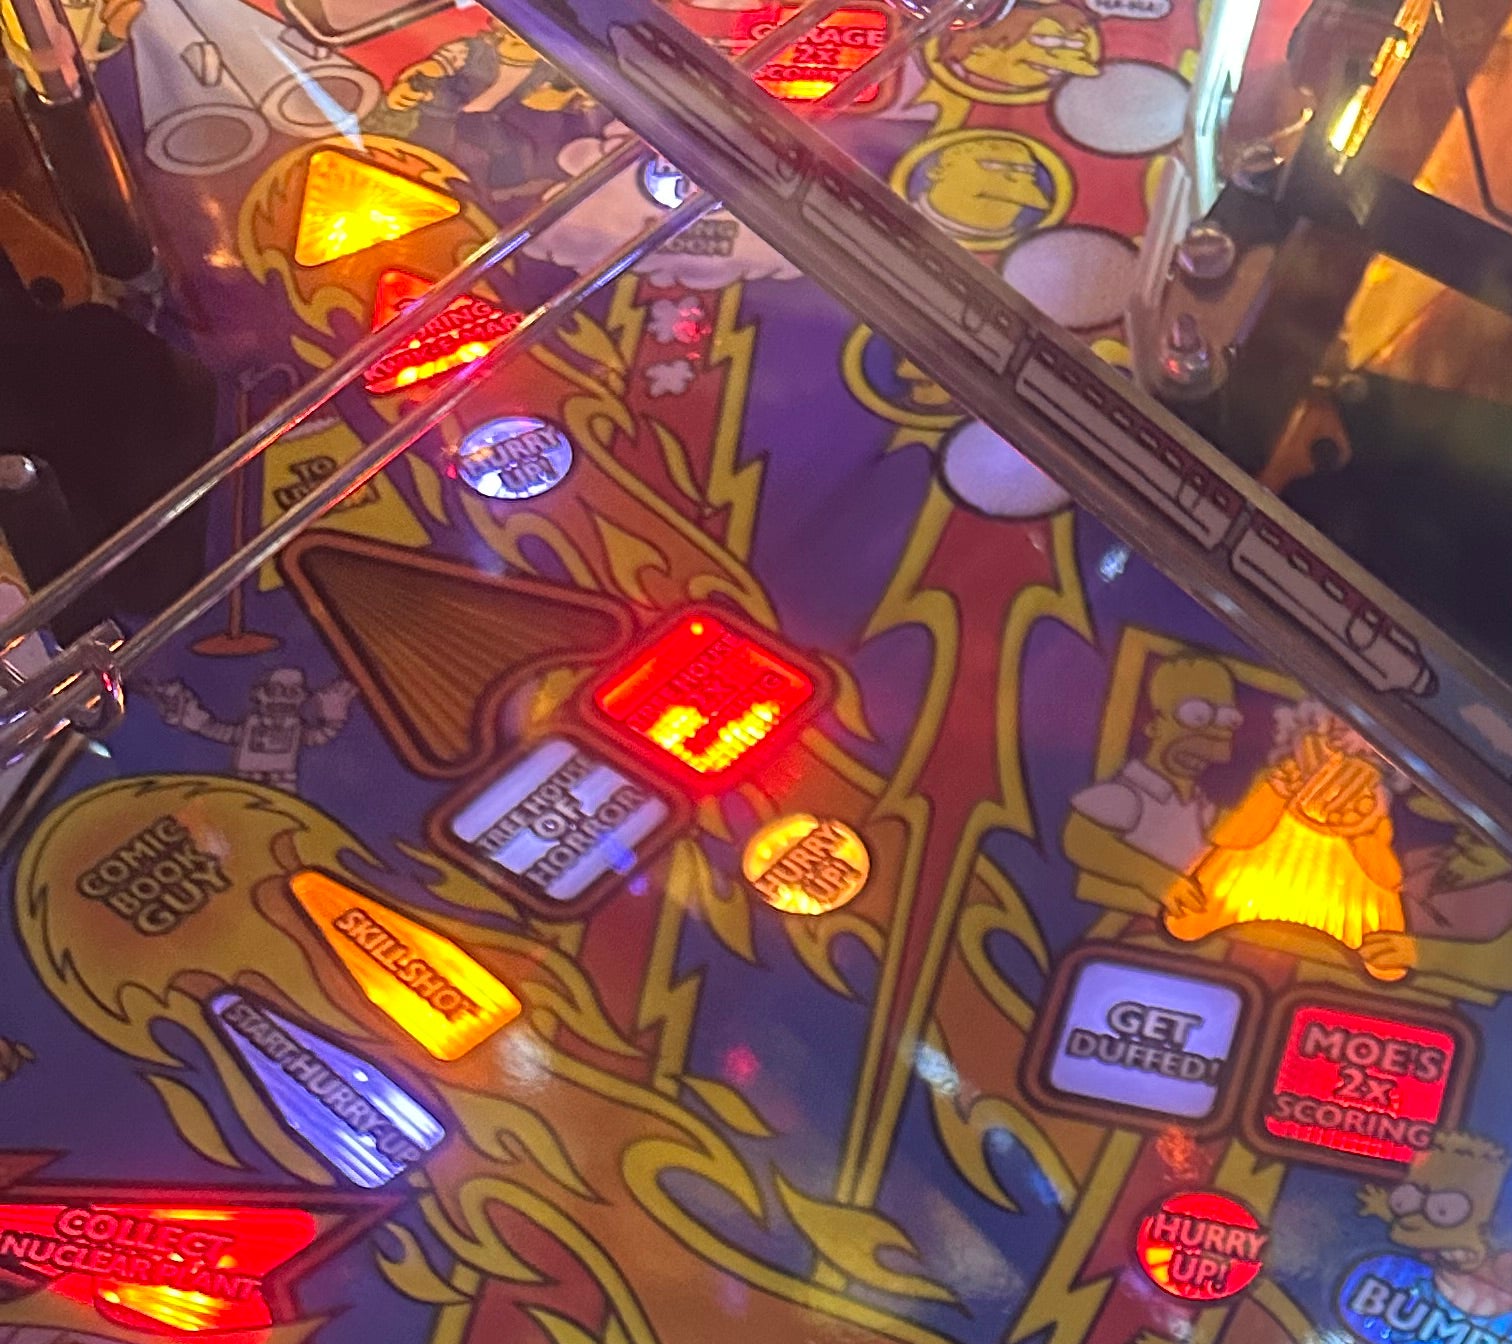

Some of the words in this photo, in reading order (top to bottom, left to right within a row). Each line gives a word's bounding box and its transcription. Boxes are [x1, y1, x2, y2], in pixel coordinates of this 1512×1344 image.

[751, 23, 884, 46] GRAGE
[461, 428, 563, 477] HURRY
[526, 786, 645, 887] HORROR
[534, 793, 582, 840] OF
[81, 819, 187, 897] COMIC
[108, 843, 209, 916] BOOK
[755, 822, 841, 901] HURRY
[136, 860, 226, 932] GUY
[336, 911, 407, 974] SKILL
[224, 1004, 299, 1067] START
[1110, 1004, 1202, 1045] GET
[1069, 1031, 1220, 1083] DUFFED!
[1303, 1025, 1444, 1081] MOE'S
[1275, 1096, 1433, 1148] SCORING
[57, 1207, 235, 1261] COLLECT
[1152, 1213, 1268, 1258] HURRY
[1, 1233, 151, 1281] NUCLEAR
[154, 1262, 262, 1299] PLANT
[1173, 1254, 1231, 1287] UP!
